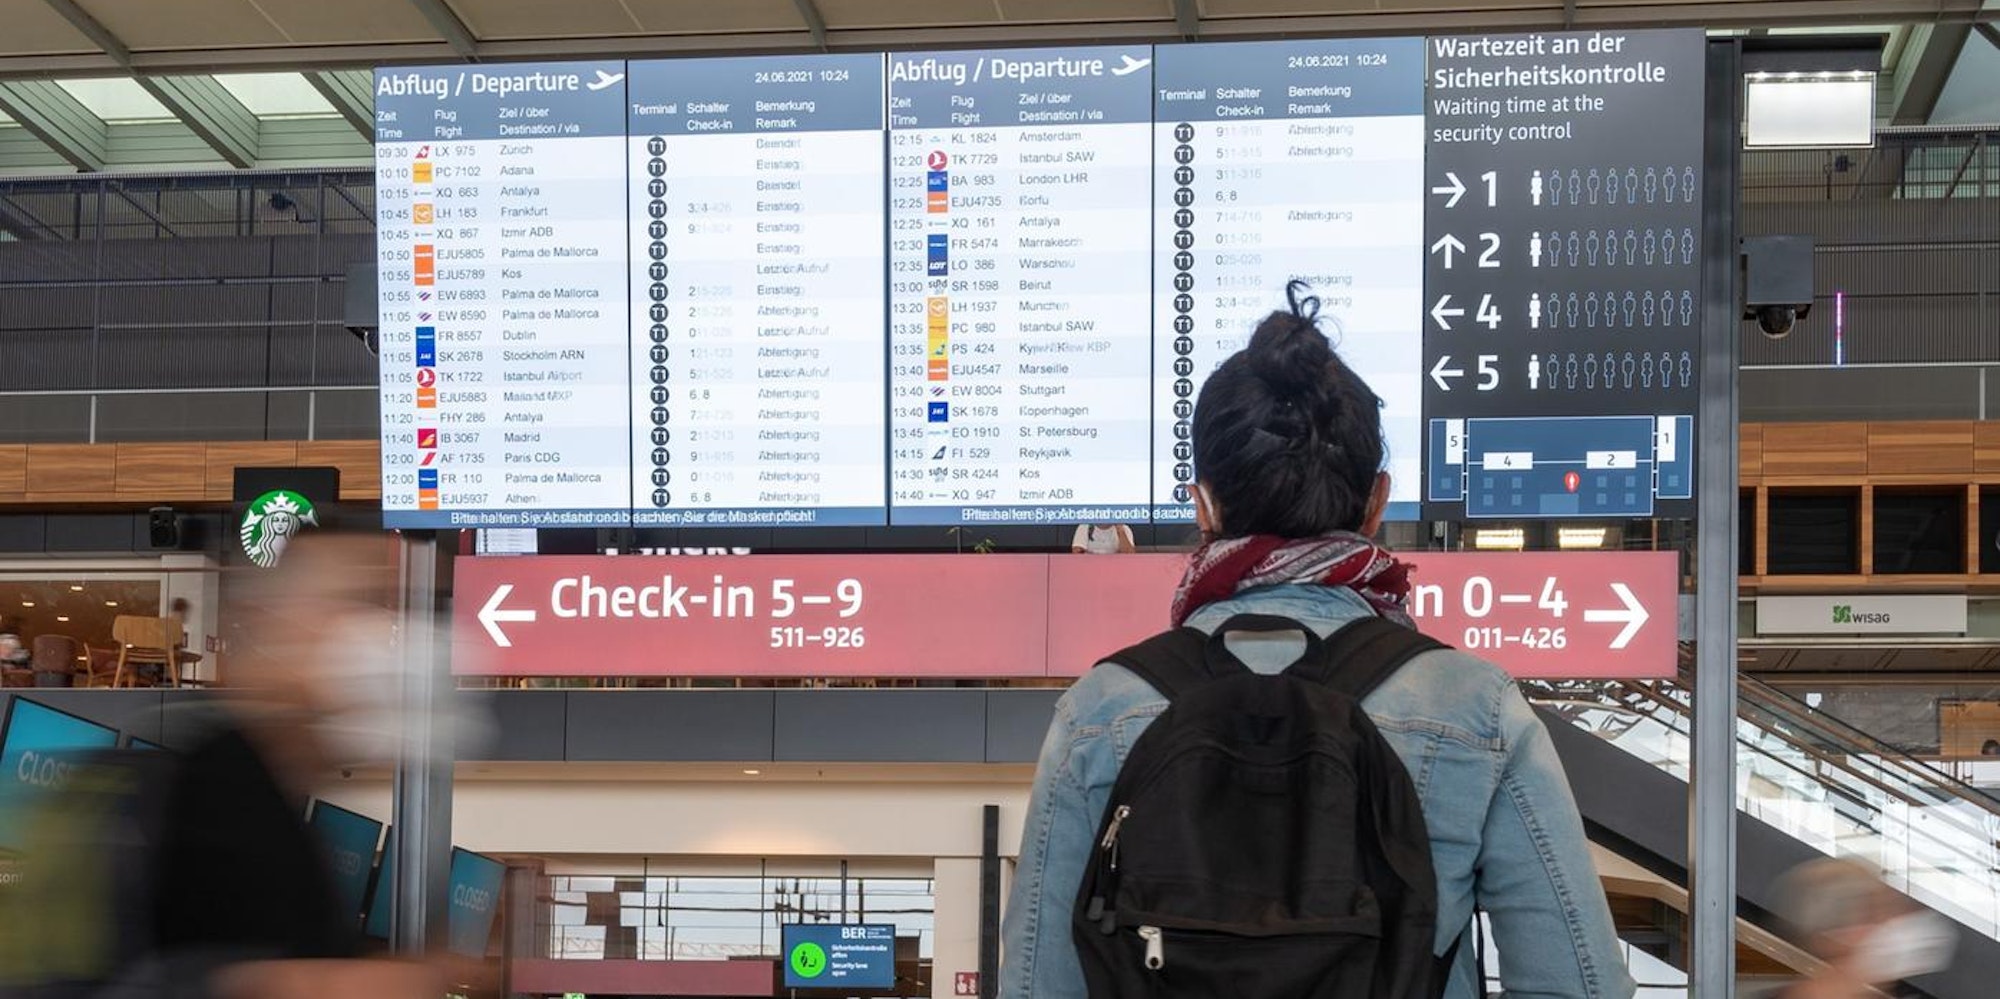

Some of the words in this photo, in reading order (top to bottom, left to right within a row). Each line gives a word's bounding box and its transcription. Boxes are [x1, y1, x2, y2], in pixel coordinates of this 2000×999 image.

[1435, 34, 1545, 58] Wartezeit
[1552, 38, 1579, 54] an
[1587, 32, 1625, 53] der
[1288, 55, 1348, 68] 24.06.2021
[1357, 54, 1387, 65] 10:24
[755, 71, 812, 83] 24.06.2021
[820, 70, 849, 81] 10:24
[892, 59, 966, 86] Abflug
[973, 58, 984, 82] /
[991, 57, 1103, 83] Departure
[1435, 62, 1665, 88] Sicherheitskontrolle
[377, 74, 448, 100] Abflug
[455, 72, 465, 96] /
[472, 72, 579, 98] Departure
[1159, 89, 1206, 101] Terminal
[1216, 88, 1261, 99] Schalter
[1288, 85, 1351, 98] Bemerkung
[892, 97, 911, 108] Zeit
[951, 95, 974, 108] Flug
[1019, 93, 1038, 105] Ziel
[1047, 93, 1072, 104] über
[1434, 97, 1500, 118] Waiting
[1506, 96, 1546, 113] time
[1552, 96, 1569, 112] at
[1574, 94, 1604, 111] the
[633, 103, 677, 115] Terminal
[687, 102, 729, 114] Schalter
[755, 100, 815, 113] Bemerkung
[1216, 105, 1264, 116] Check-in
[1288, 103, 1331, 114] Remark
[377, 111, 397, 122] Zeit
[434, 109, 456, 122] Flug
[499, 107, 518, 118] Ziel
[525, 107, 549, 118] über
[892, 114, 918, 125] Time
[951, 112, 980, 125] Flight
[1019, 111, 1078, 122] Destination
[1087, 109, 1103, 119] via
[378, 128, 403, 138] Time
[435, 126, 462, 139] Flight
[499, 124, 556, 135] Destination
[564, 123, 580, 133] via
[686, 119, 733, 131] Check-in
[756, 118, 797, 129] Remark
[951, 133, 966, 144] KL
[970, 132, 997, 144] 1824
[1018, 131, 1081, 142] Amsterdam
[1434, 124, 1503, 145] security
[1509, 121, 1572, 140] control
[951, 154, 967, 165] TK
[970, 153, 998, 165] 7729
[1019, 153, 1063, 163] Istanbul
[1066, 151, 1095, 163] SAW
[435, 166, 452, 178] PC
[455, 165, 481, 177] 7102
[499, 165, 535, 176] Adana
[951, 175, 968, 186] BA
[973, 175, 995, 186] 983
[1019, 174, 1061, 185] London
[1063, 172, 1088, 184] LHR
[1481, 171, 1496, 207] 1
[437, 248, 485, 260] EJU5805
[501, 247, 535, 258] Palma
[537, 248, 551, 258] de
[553, 247, 599, 257] Mallorca
[1478, 232, 1500, 268] 2
[437, 269, 485, 280] EJU5789
[501, 267, 523, 279] Kos
[952, 280, 969, 292] SR
[972, 280, 999, 291] 1598
[1019, 279, 1052, 291] Beirut
[1476, 294, 1502, 329] 4
[438, 330, 454, 342] FR
[502, 329, 537, 341] Dublin
[438, 351, 455, 362] SK
[503, 350, 557, 362] Stockholm
[559, 349, 585, 360] ARN
[952, 364, 1001, 376] EJU4547
[1019, 363, 1069, 374] Marseille
[1477, 355, 1499, 390] 5
[951, 385, 973, 396] EW
[975, 385, 1002, 396] 8004
[1019, 384, 1065, 397] Stuttgart
[440, 432, 452, 444] IB
[454, 432, 480, 443] 3067
[504, 432, 541, 443] Madrid
[1450, 435, 1458, 447] 5
[1664, 432, 1669, 444] 1
[440, 453, 455, 463] AF
[459, 452, 485, 463] 1735
[504, 452, 532, 463] Paris
[534, 452, 561, 463] CDG
[952, 447, 963, 458] FI
[969, 448, 990, 459] 529
[1019, 447, 1072, 460] Reykjavik
[1607, 454, 1615, 466] 2
[1503, 455, 1512, 467] 4
[441, 473, 457, 484] FR
[464, 473, 482, 484] 110
[505, 472, 538, 483] Palma
[540, 473, 554, 483] de
[556, 472, 601, 483] Mallorca
[952, 468, 969, 480] SR
[971, 468, 999, 480] 4244
[1019, 468, 1040, 479] Kos
[952, 488, 969, 500] XQ
[975, 489, 996, 500] 947
[1019, 489, 1046, 500] Izmir
[1048, 488, 1074, 499] ADB
[551, 575, 754, 618] Check-in
[771, 579, 862, 617] 5–9
[841, 927, 867, 939] BER
